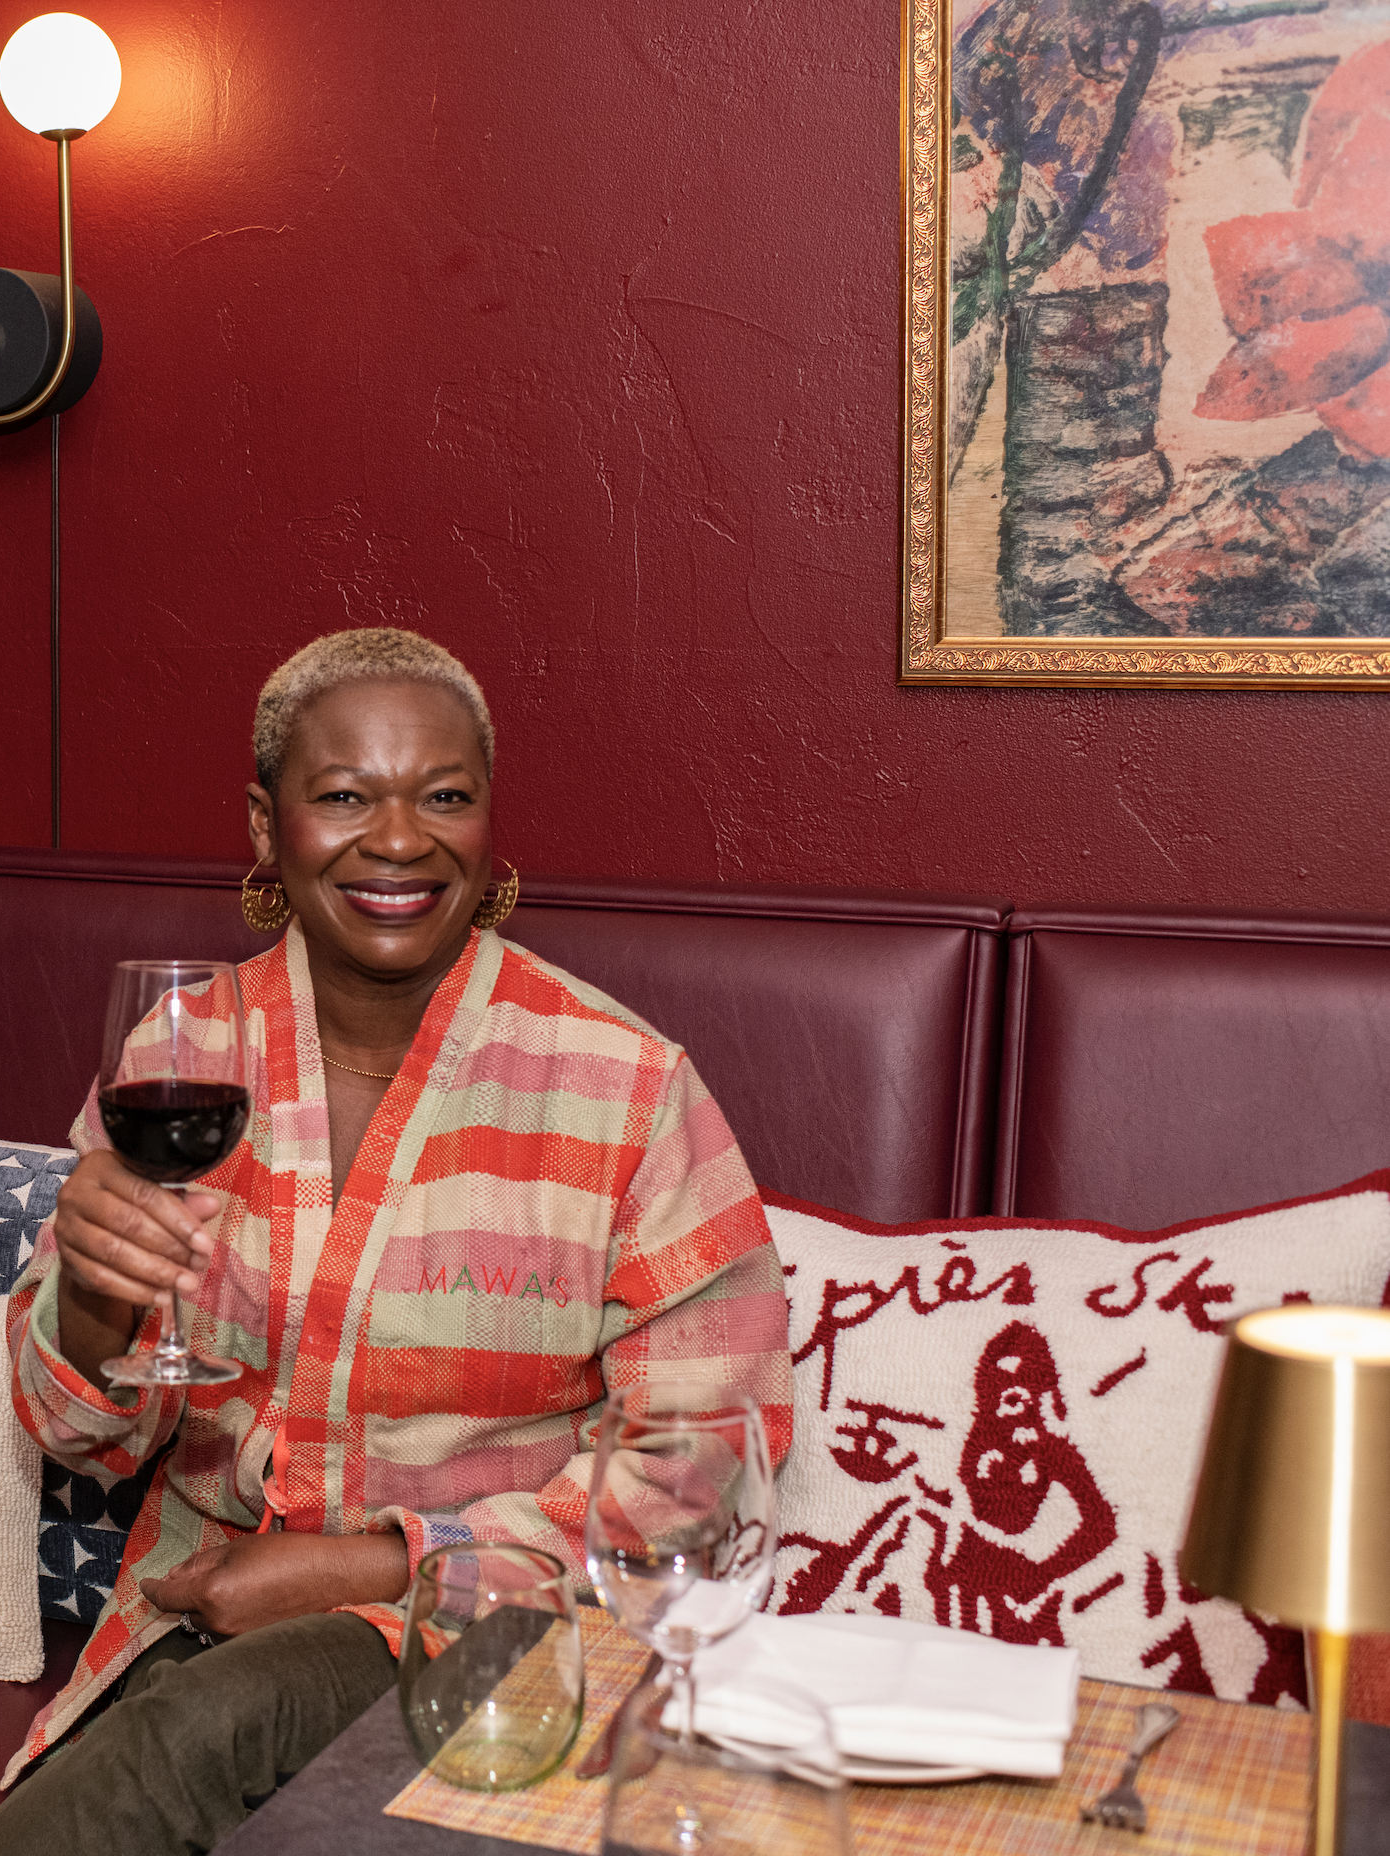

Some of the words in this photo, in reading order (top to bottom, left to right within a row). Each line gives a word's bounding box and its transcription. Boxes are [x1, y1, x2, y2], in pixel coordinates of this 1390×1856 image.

[418, 1264, 568, 1308] MAWA'S
[782, 1239, 1036, 1412] près
[1084, 1250, 1311, 1336] Sk
